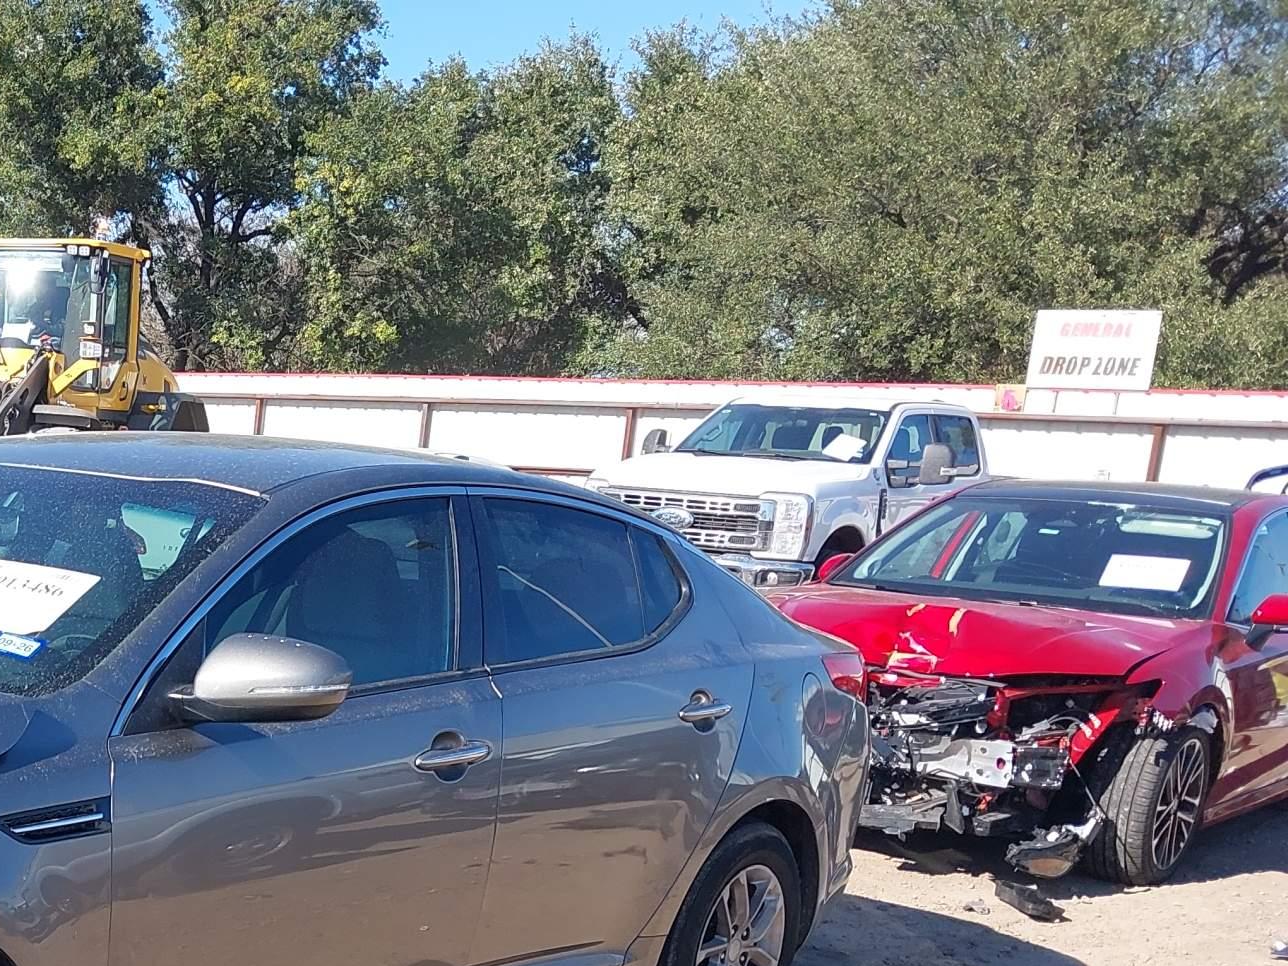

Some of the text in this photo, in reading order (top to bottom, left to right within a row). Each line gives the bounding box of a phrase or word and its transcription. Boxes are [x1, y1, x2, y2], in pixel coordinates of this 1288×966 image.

[1060, 322, 1133, 337] GENERAL
[1039, 356, 1141, 376] DROP ZONE
